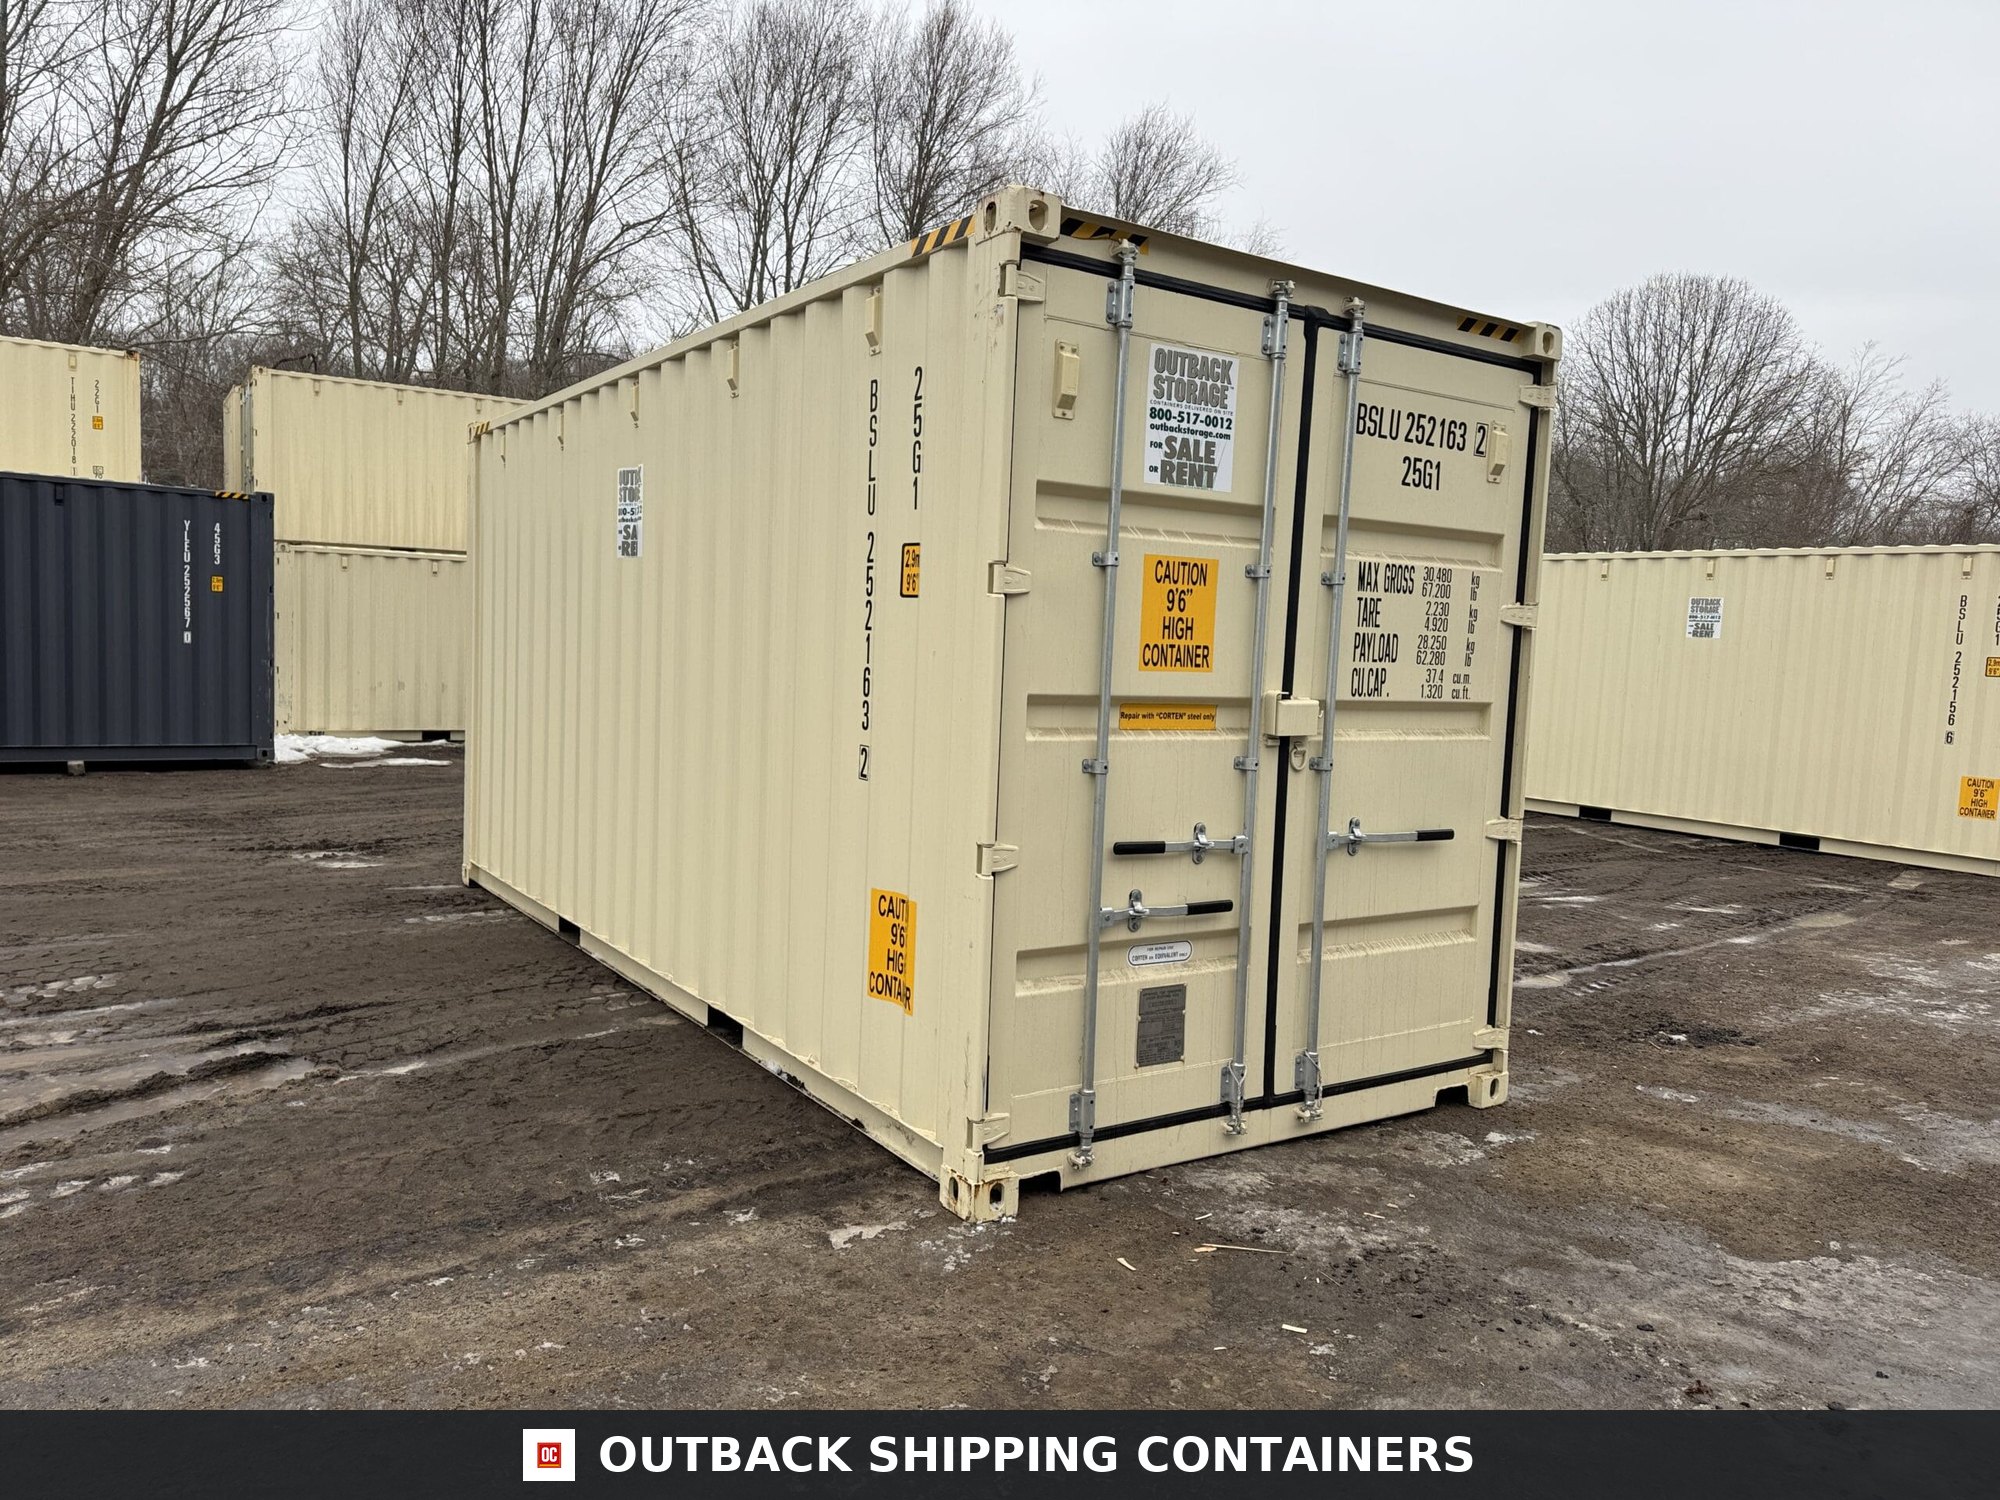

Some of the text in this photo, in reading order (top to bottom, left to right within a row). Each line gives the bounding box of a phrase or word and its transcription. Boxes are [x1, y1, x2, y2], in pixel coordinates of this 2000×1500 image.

[1154, 347, 1233, 385] OUTBACK
[1153, 374, 1229, 409] STORAGE
[1149, 407, 1232, 430] 800-517-0012
[1149, 422, 1231, 440] outbackstorage.com
[1356, 402, 1486, 456] BSLU 252163 2
[867, 379, 878, 516] BSLU
[912, 366, 923, 510] 25G1
[1149, 435, 1216, 464] FOR SALE
[1148, 465, 1159, 473] OR
[1160, 459, 1218, 489] RENT
[1401, 456, 1441, 491] 25G1
[1154, 559, 1208, 587] CAUTION
[1357, 561, 1380, 593] MAX
[1383, 563, 1416, 595] GROSS
[1471, 571, 1481, 590] kg
[1470, 586, 1478, 602] lb
[1357, 597, 1382, 628] TARE
[1468, 604, 1478, 622] kg
[1694, 622, 1714, 630] SALE
[1956, 595, 1968, 646] BSLU
[861, 531, 874, 730] 252163
[1162, 615, 1194, 641] HIGH
[1467, 619, 1475, 635] lb
[1692, 630, 1715, 638] RENT
[1142, 643, 1210, 669] CONTAINER
[1352, 632, 1399, 664] PAYLOAD
[1465, 637, 1475, 655] kg
[1464, 652, 1472, 668] lb
[1948, 650, 1962, 726] 252156
[1120, 712, 1140, 721] Repair
[1203, 713, 1215, 722] only
[1966, 778, 1995, 789] CAUTION
[1959, 807, 1996, 819] CONTAINER
[1970, 797, 1988, 808] HIGH
